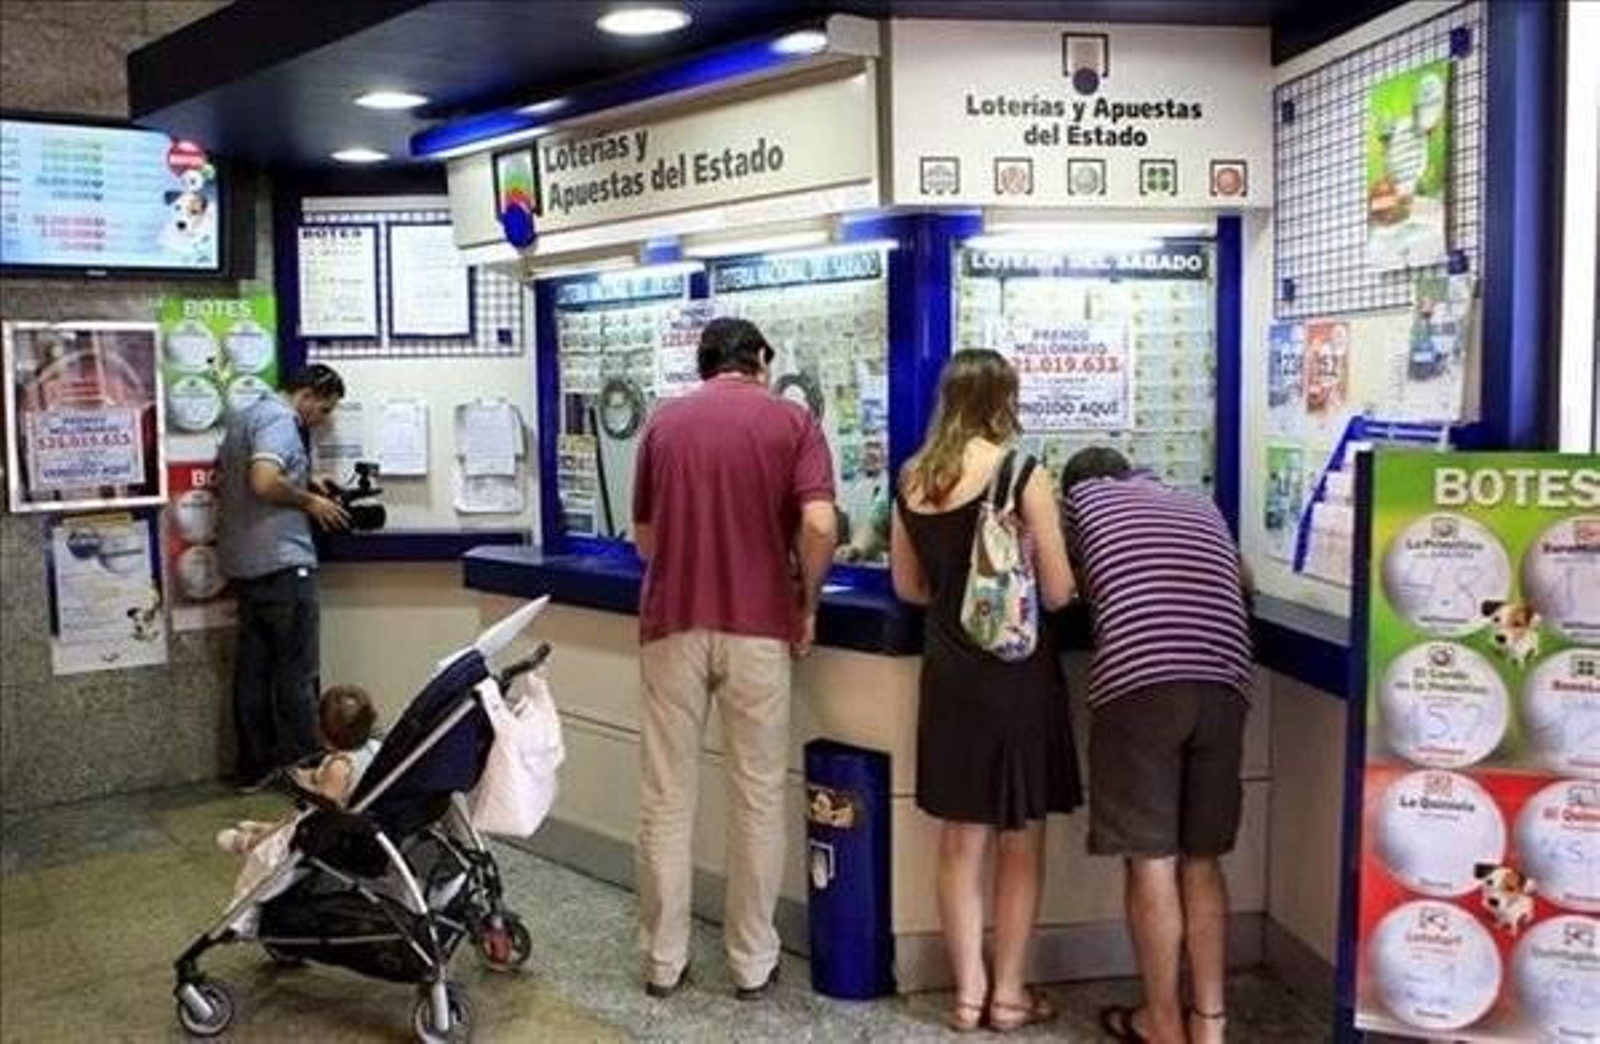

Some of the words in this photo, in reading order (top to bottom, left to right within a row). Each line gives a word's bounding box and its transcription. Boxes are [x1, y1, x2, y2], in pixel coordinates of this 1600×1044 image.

[965, 94, 1066, 117] Loterías
[1072, 100, 1085, 122] y
[1093, 97, 1203, 124] Apuestas
[634, 130, 648, 162] y
[1023, 124, 1060, 146] del
[1066, 125, 1149, 147] Estado
[549, 171, 645, 214] Apuestas
[651, 154, 687, 192] del
[693, 137, 784, 185] Estado
[183, 299, 254, 318] BOTES
[1433, 467, 1600, 508] BOTES
